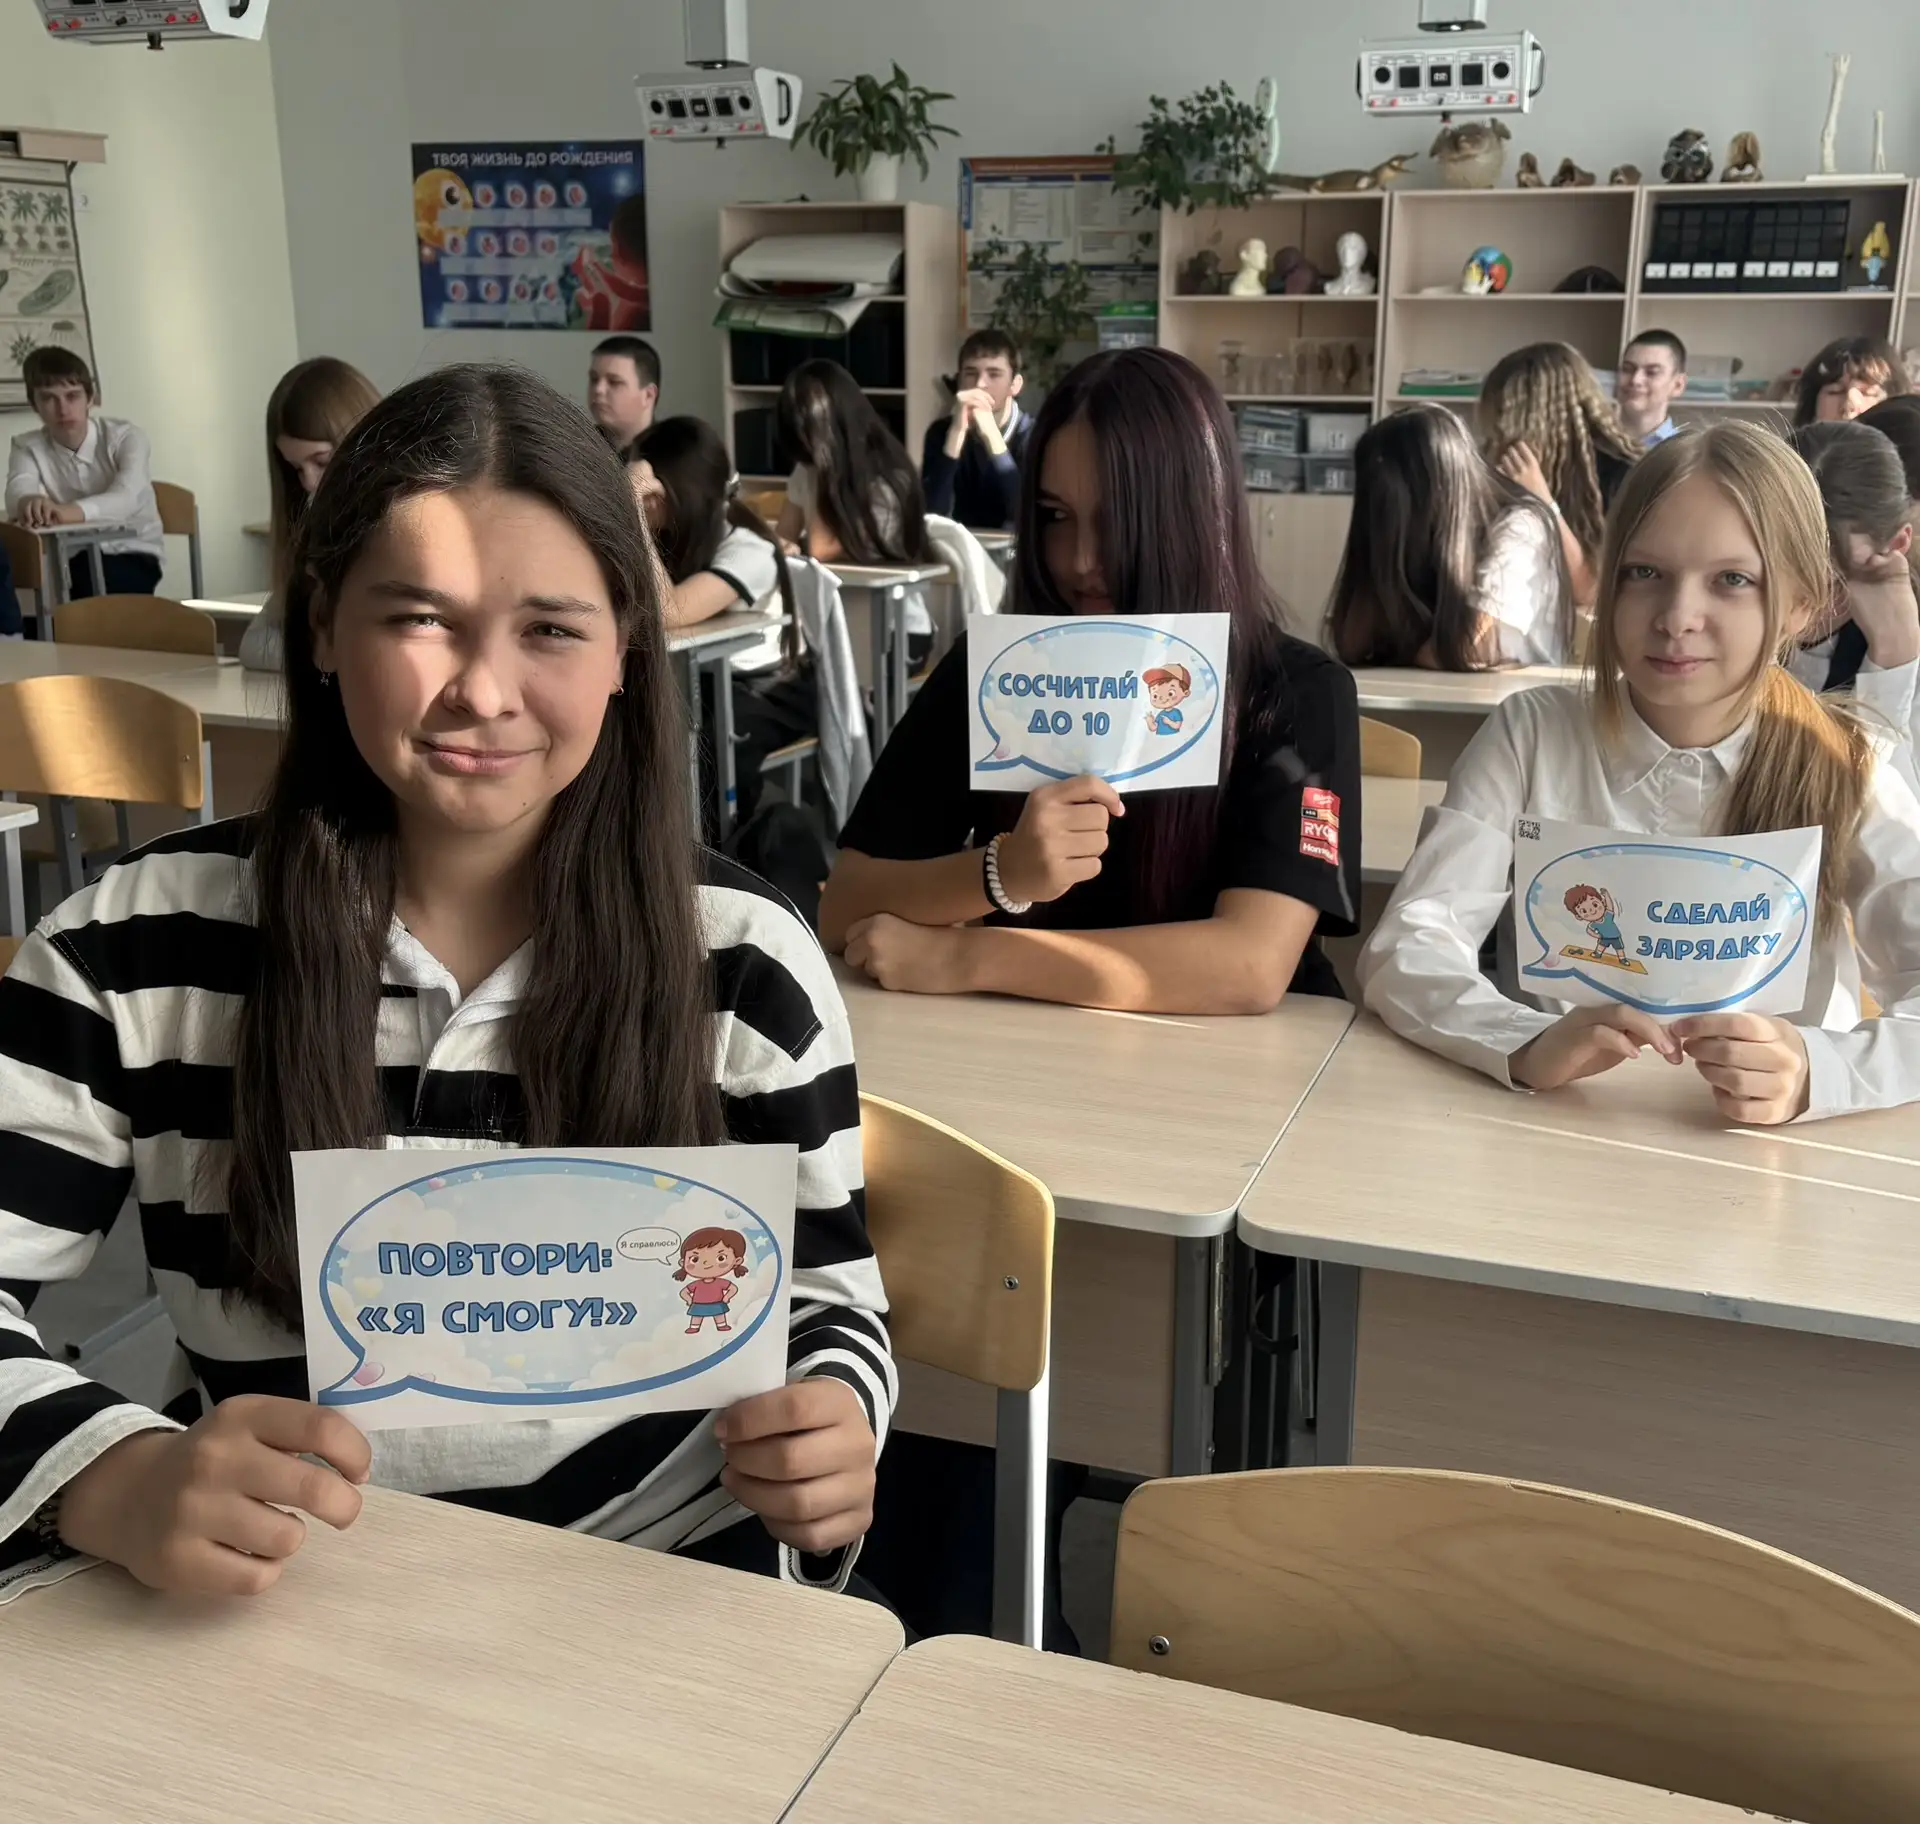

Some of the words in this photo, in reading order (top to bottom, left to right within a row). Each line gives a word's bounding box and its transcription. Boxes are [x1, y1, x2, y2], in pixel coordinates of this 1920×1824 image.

[432, 152, 469, 167] ТВОЯ
[471, 152, 523, 166] ЖИЗНЬ
[525, 152, 547, 168] ДО
[549, 151, 634, 166] РОЖДЕНИЯ
[998, 670, 1139, 699] СОСЧИТАЙ
[1027, 709, 1073, 735] ДО
[1082, 711, 1110, 736] 10
[1647, 893, 1770, 925] СДЕЛАЙ
[1636, 932, 1781, 960] ЗАРЯДКУ
[620, 1241, 627, 1249] Я
[629, 1238, 678, 1249] справлюсь!
[378, 1241, 614, 1278] ПОВТОРИ:
[357, 1302, 425, 1335] «Я
[442, 1298, 638, 1334] СМОГУ!»
